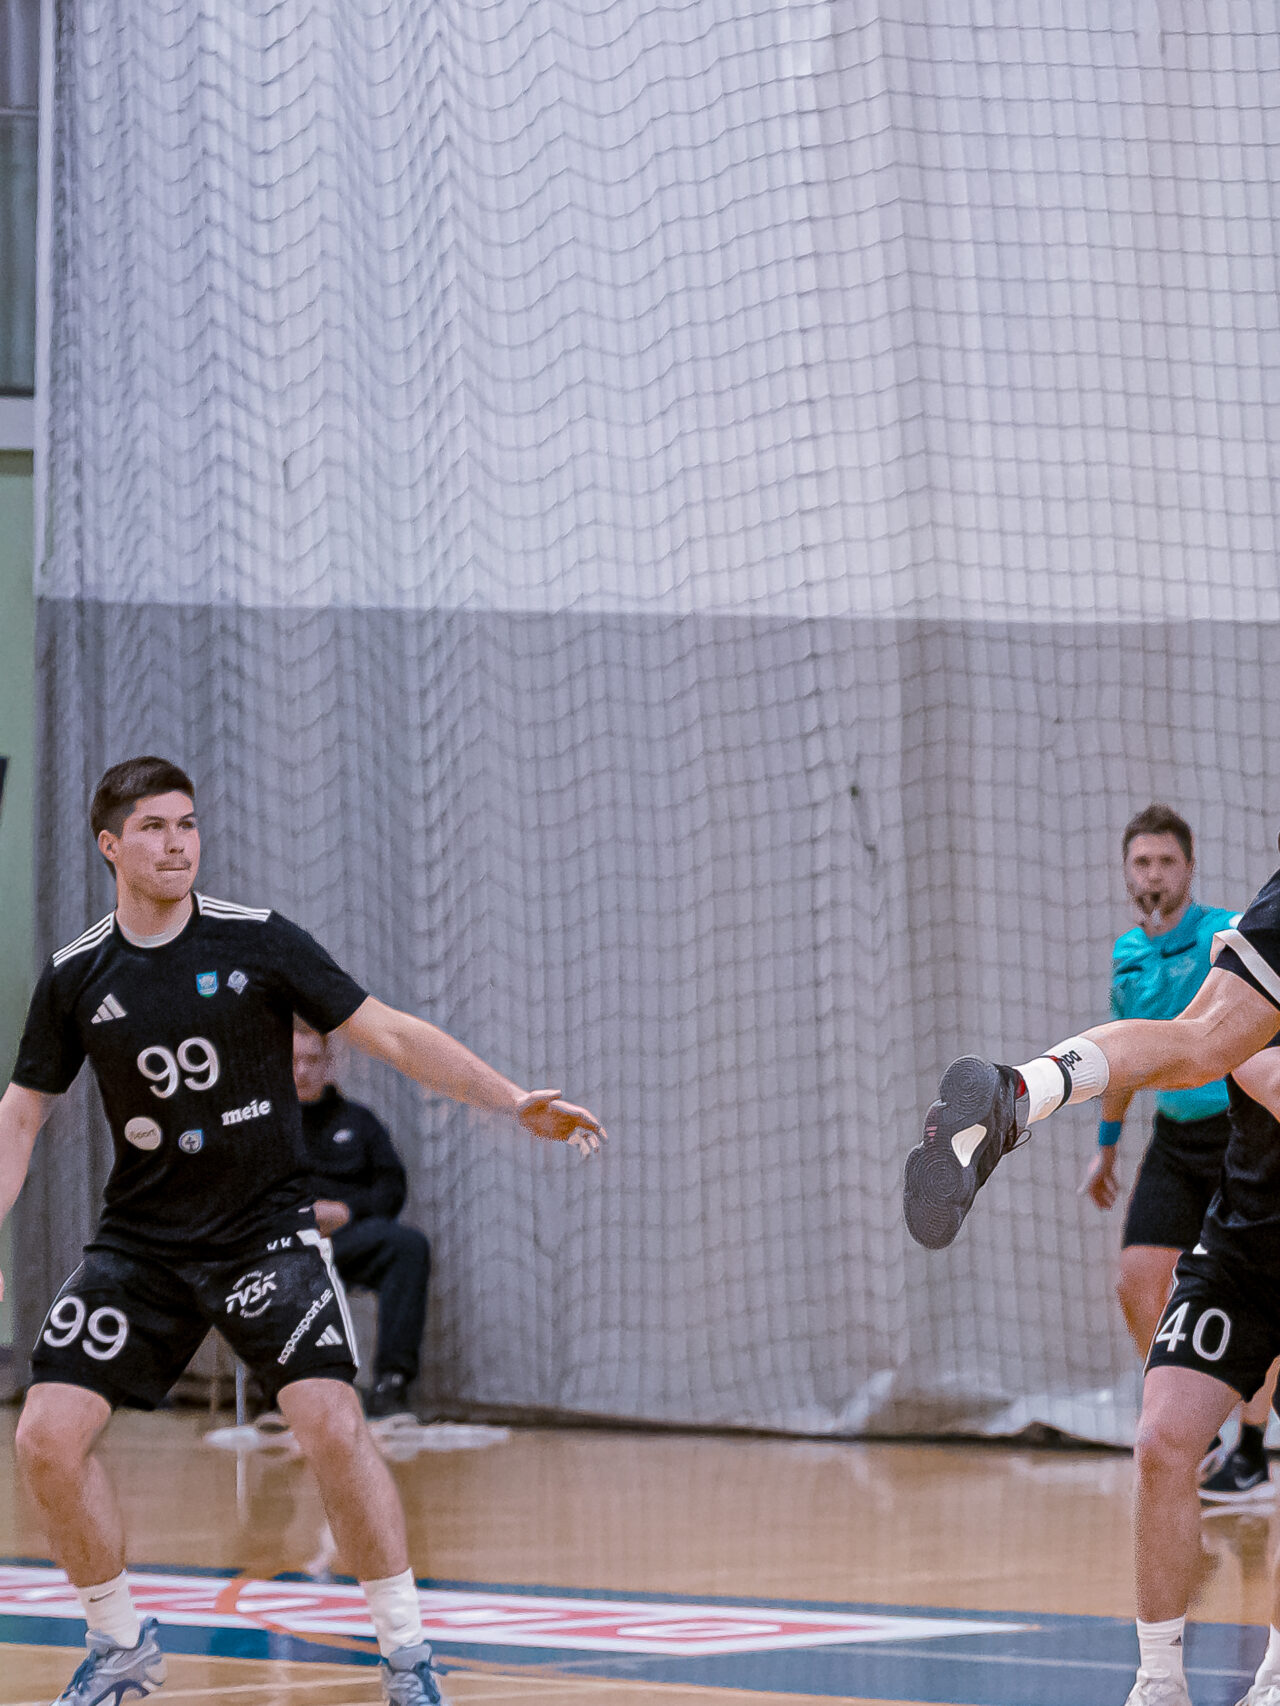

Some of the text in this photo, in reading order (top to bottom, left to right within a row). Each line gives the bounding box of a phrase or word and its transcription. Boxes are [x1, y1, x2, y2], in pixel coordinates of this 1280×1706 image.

[137, 1037, 219, 1098] 99
[221, 1099, 271, 1126] meie
[43, 1296, 129, 1360] 99
[1155, 1301, 1231, 1361] 40
